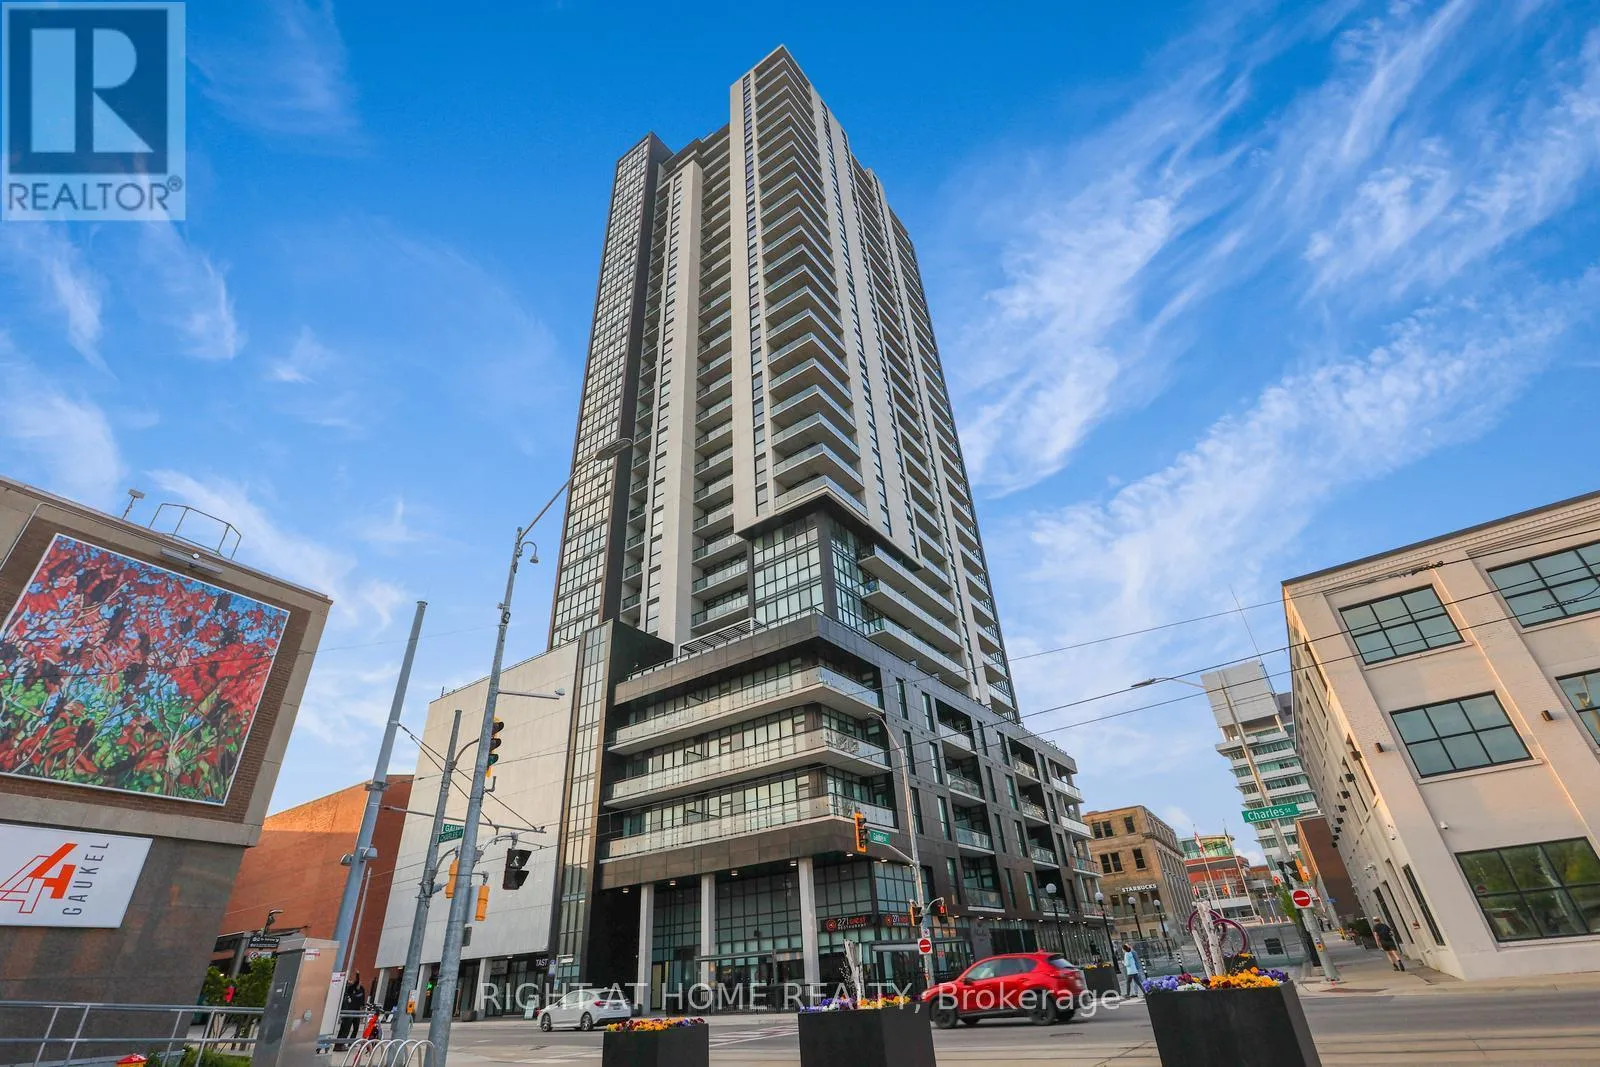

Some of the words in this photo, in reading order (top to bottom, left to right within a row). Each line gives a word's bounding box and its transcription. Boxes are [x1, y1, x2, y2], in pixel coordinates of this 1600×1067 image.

[1248, 809, 1285, 820] Charles
[62, 842, 109, 915] GAUKEL
[1121, 883, 1157, 892] STARBUCKS
